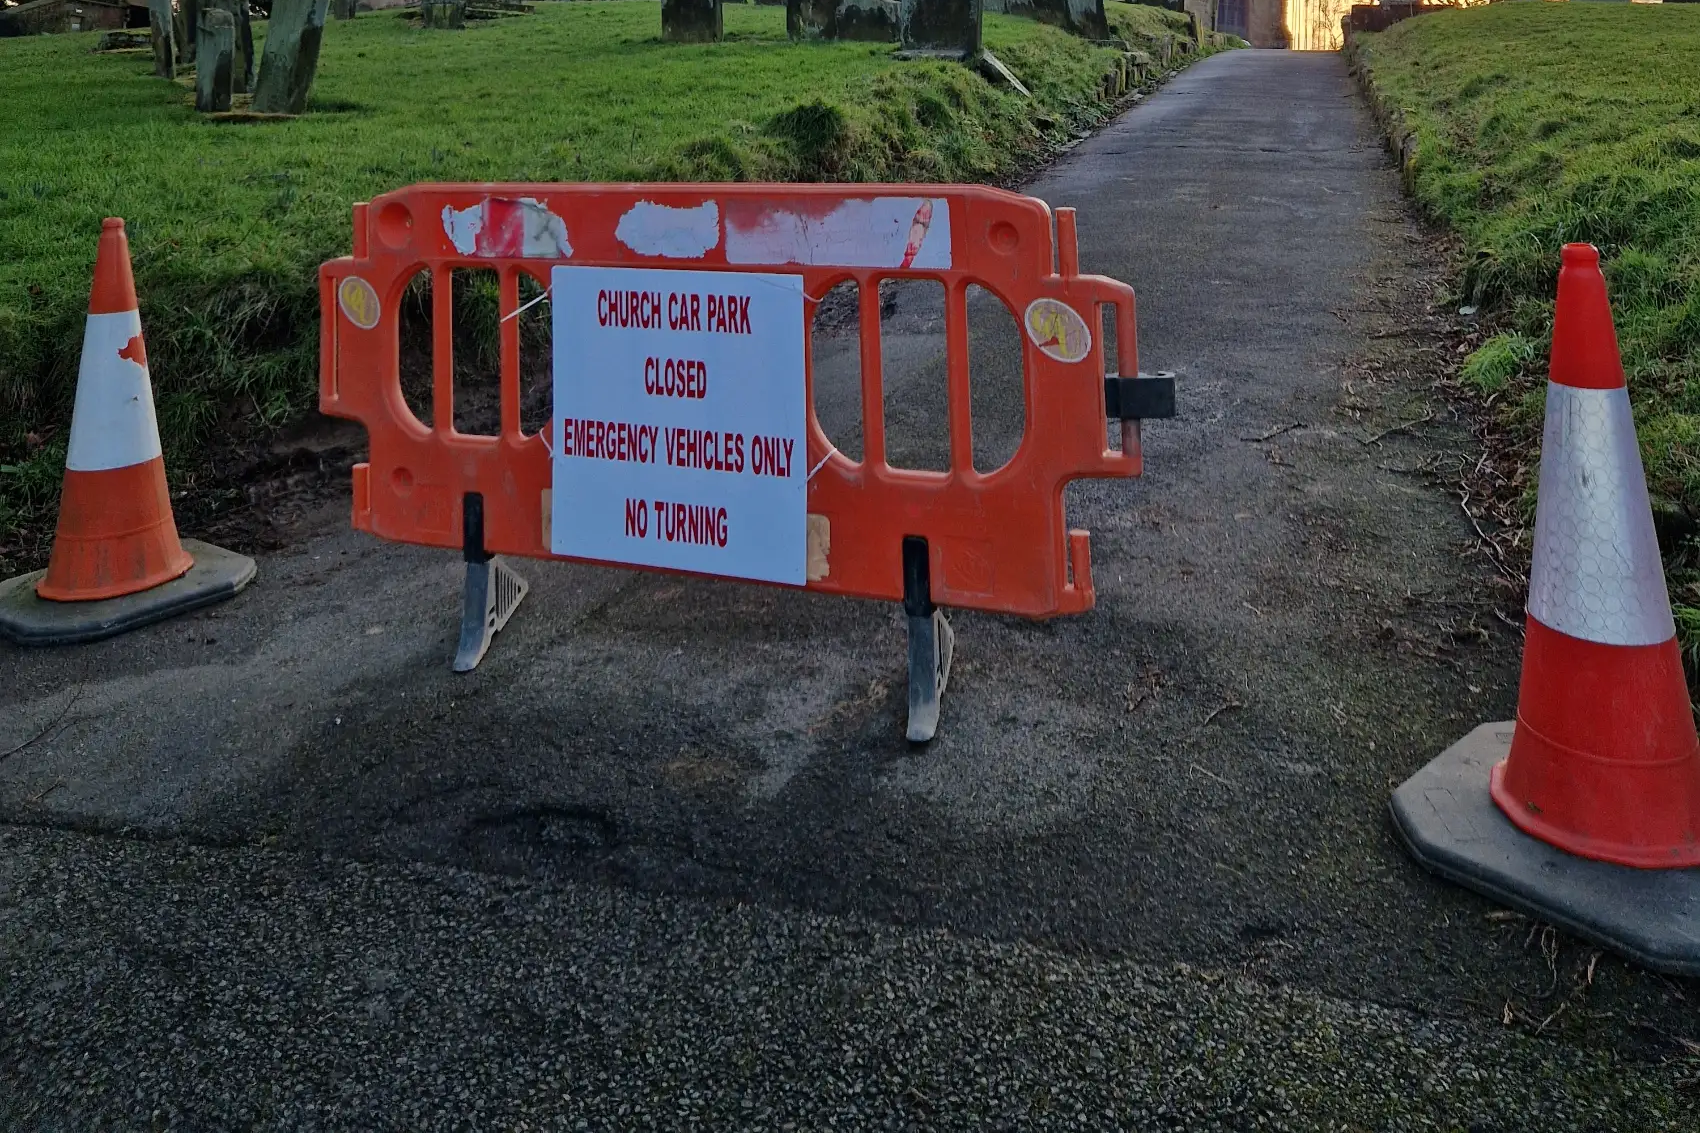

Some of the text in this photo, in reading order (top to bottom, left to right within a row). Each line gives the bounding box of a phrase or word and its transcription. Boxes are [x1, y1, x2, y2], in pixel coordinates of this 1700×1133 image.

[598, 289, 752, 335] CHURCH CAR PARK
[644, 356, 707, 399] CLOSED
[564, 418, 794, 478] EMERGENCY VEHICLES ONLY
[625, 497, 728, 548] NO TURNING
